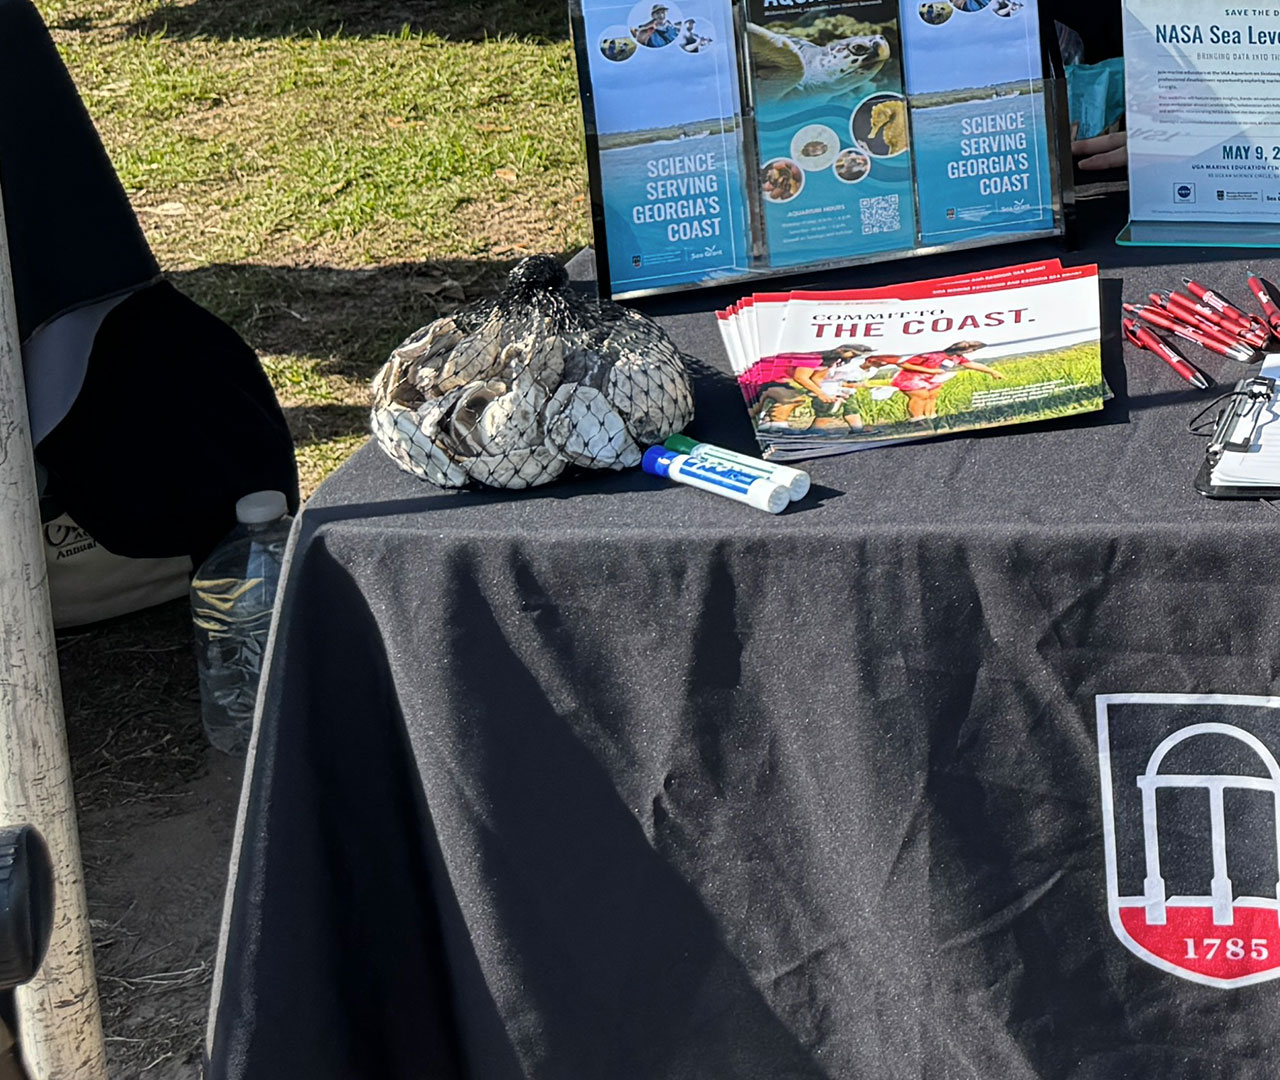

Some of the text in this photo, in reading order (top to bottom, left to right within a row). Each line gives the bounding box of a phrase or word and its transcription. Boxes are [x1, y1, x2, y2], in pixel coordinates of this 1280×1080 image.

[1224, 8, 1248, 17] SAVE
[1252, 9, 1270, 17] THE
[1156, 24, 1204, 44] NASA
[1209, 25, 1242, 45] Sea
[961, 111, 1026, 135] SCIENCE
[960, 132, 1027, 157] SERVING
[1222, 145, 1250, 160] MAY
[1255, 147, 1268, 162] 9,
[647, 153, 716, 178] SCIENCE
[947, 152, 1029, 179] GEORGIA'S
[646, 175, 718, 200] SERVING
[980, 173, 1030, 196] COAST
[632, 196, 721, 224] GEORGIA'S
[667, 217, 722, 242] COAST
[811, 307, 1036, 338] THE COAST.
[812, 308, 945, 322] COMMIT TO
[1183, 936, 1270, 962] 1785
